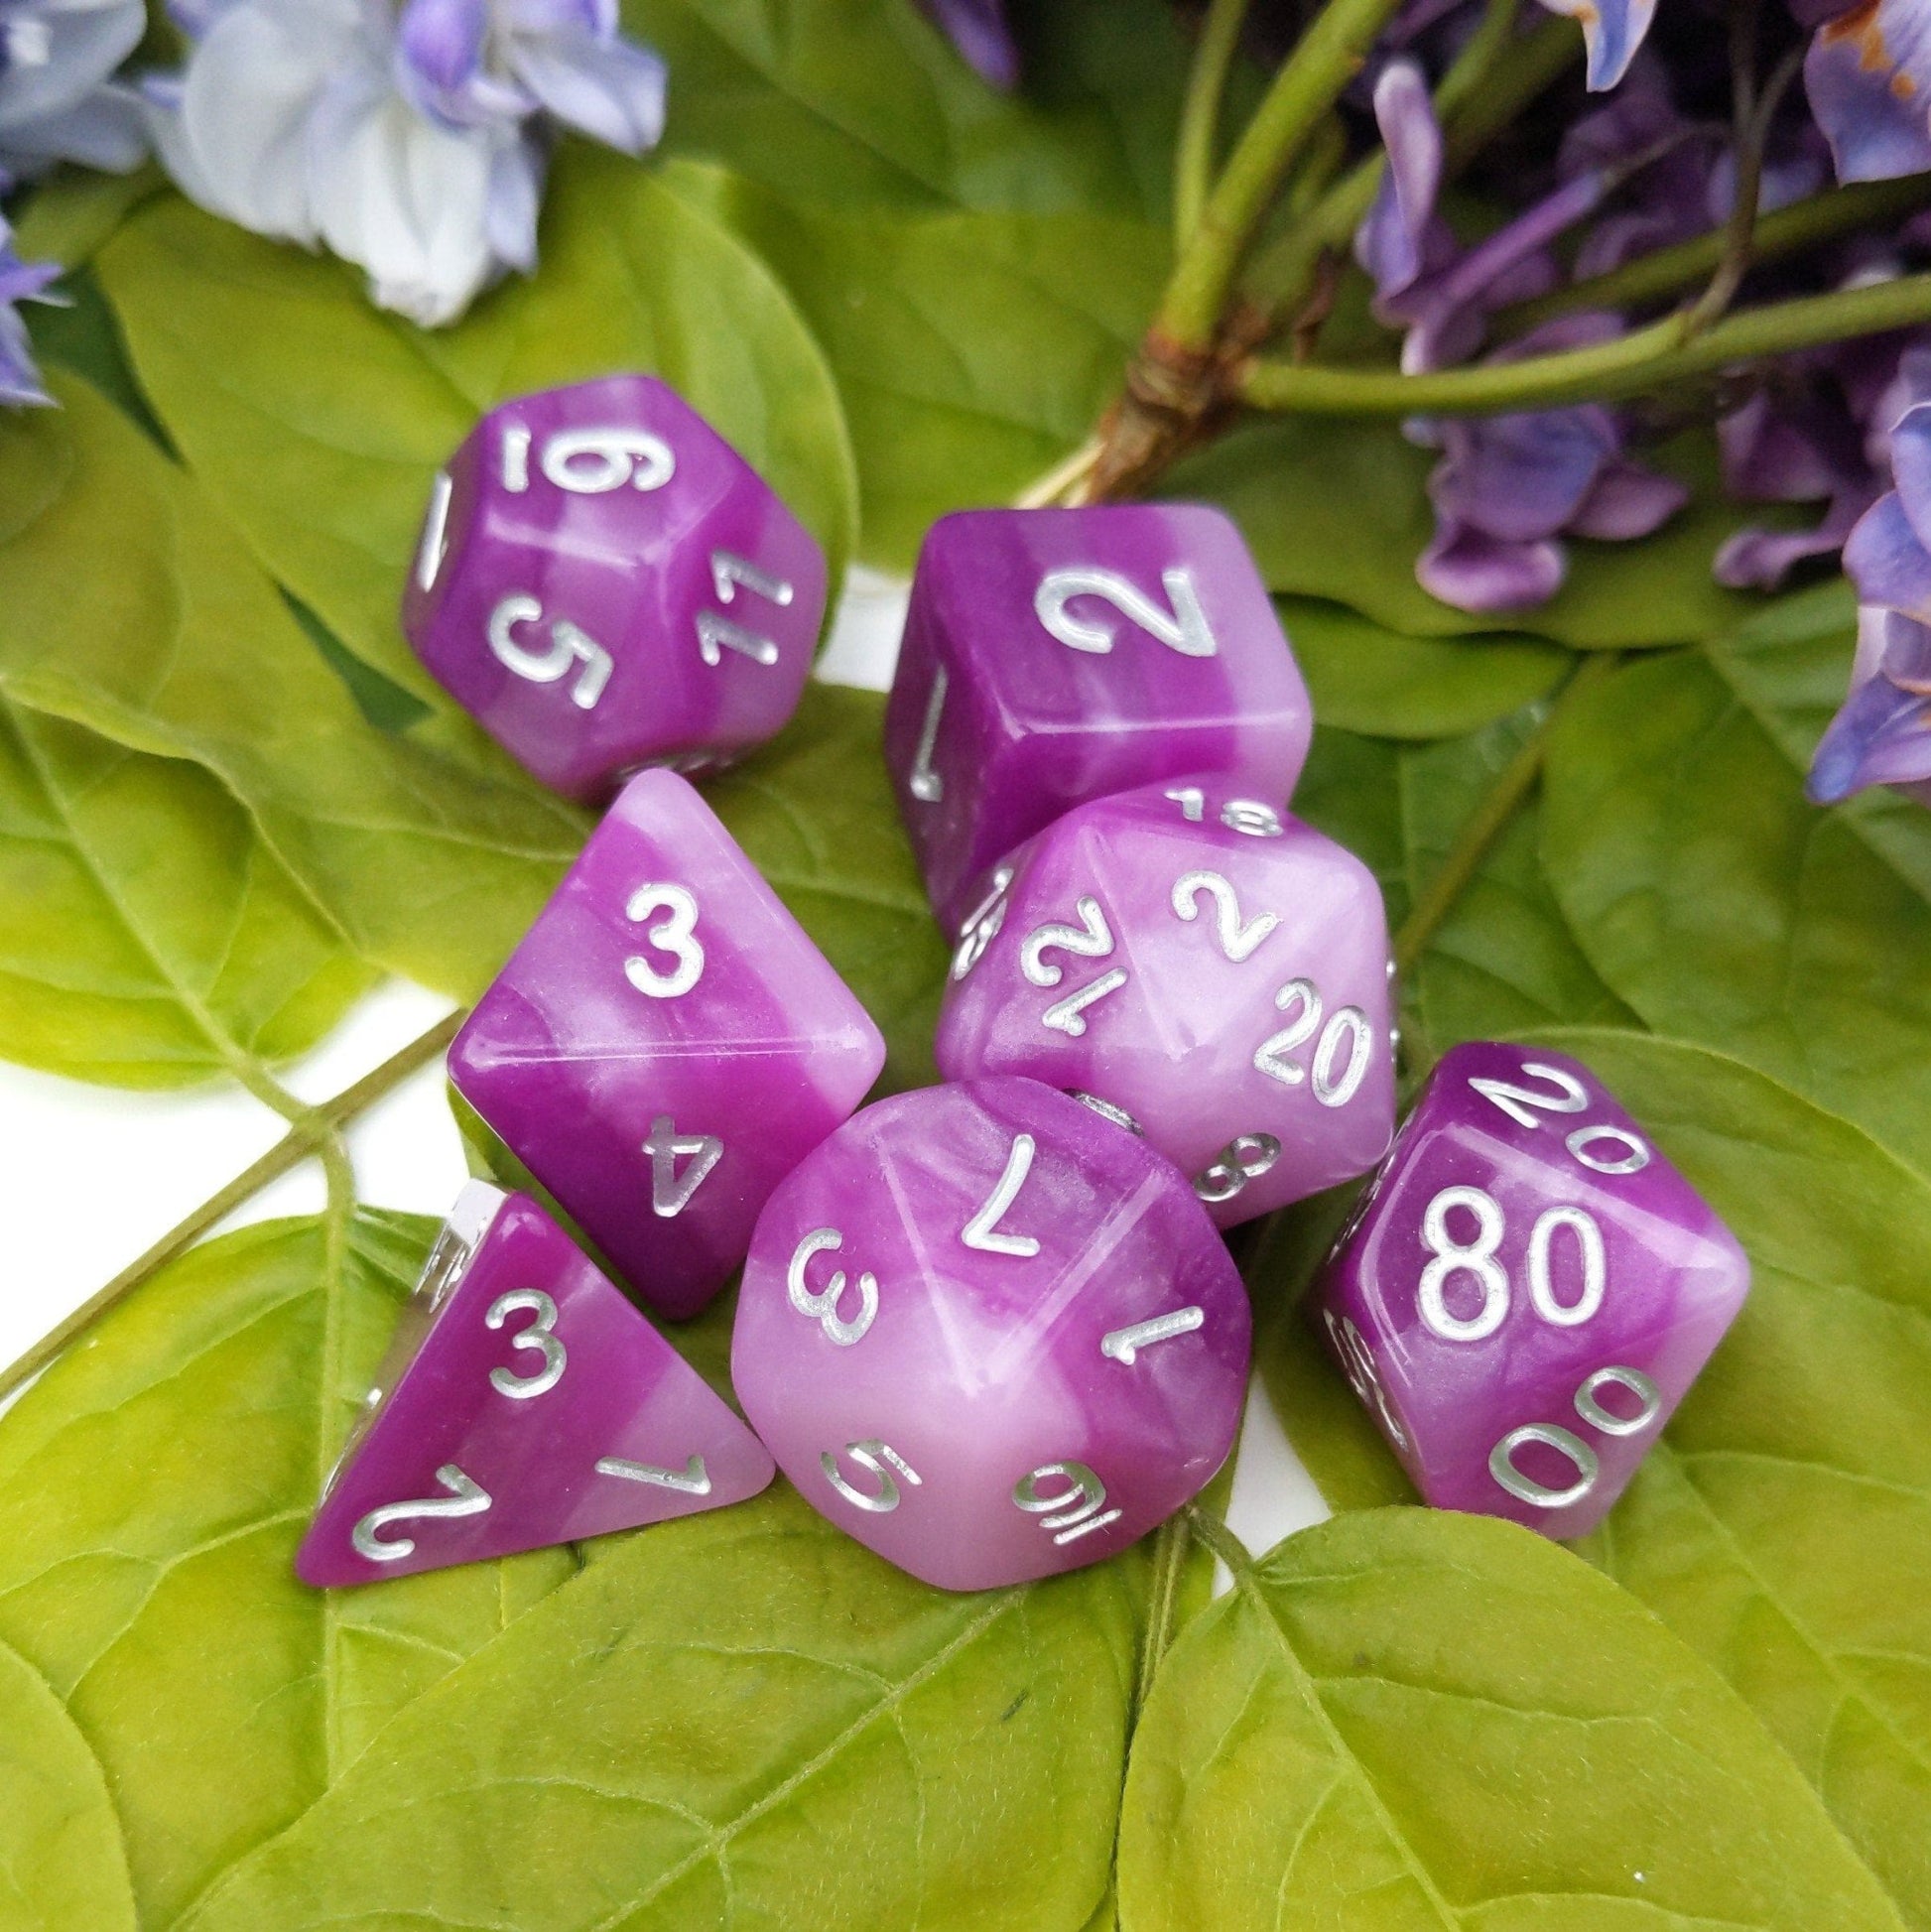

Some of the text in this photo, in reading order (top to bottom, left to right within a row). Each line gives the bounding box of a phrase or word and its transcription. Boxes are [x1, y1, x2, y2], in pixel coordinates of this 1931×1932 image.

[501, 425, 676, 494] 6
[485, 593, 615, 710] 5
[697, 548, 793, 667] 11
[1034, 566, 1216, 657] 2
[624, 883, 705, 998] 3
[1021, 895, 1128, 1038] 12
[1171, 869, 1284, 964] 2
[1253, 976, 1373, 1107] 20
[642, 1115, 724, 1218] 4
[1193, 1132, 1281, 1202] 8
[1468, 1063, 1650, 1175] 20
[962, 1133, 1041, 1257] 7
[787, 1227, 879, 1347] 3
[1417, 1185, 1607, 1342] 80
[485, 1288, 568, 1399] 3
[1100, 1305, 1204, 1365] 1
[595, 1456, 711, 1495] 1
[820, 1438, 923, 1513] 5
[1487, 1364, 1661, 1508] 00
[352, 1464, 493, 1561] 2
[1012, 1460, 1123, 1545] 9
